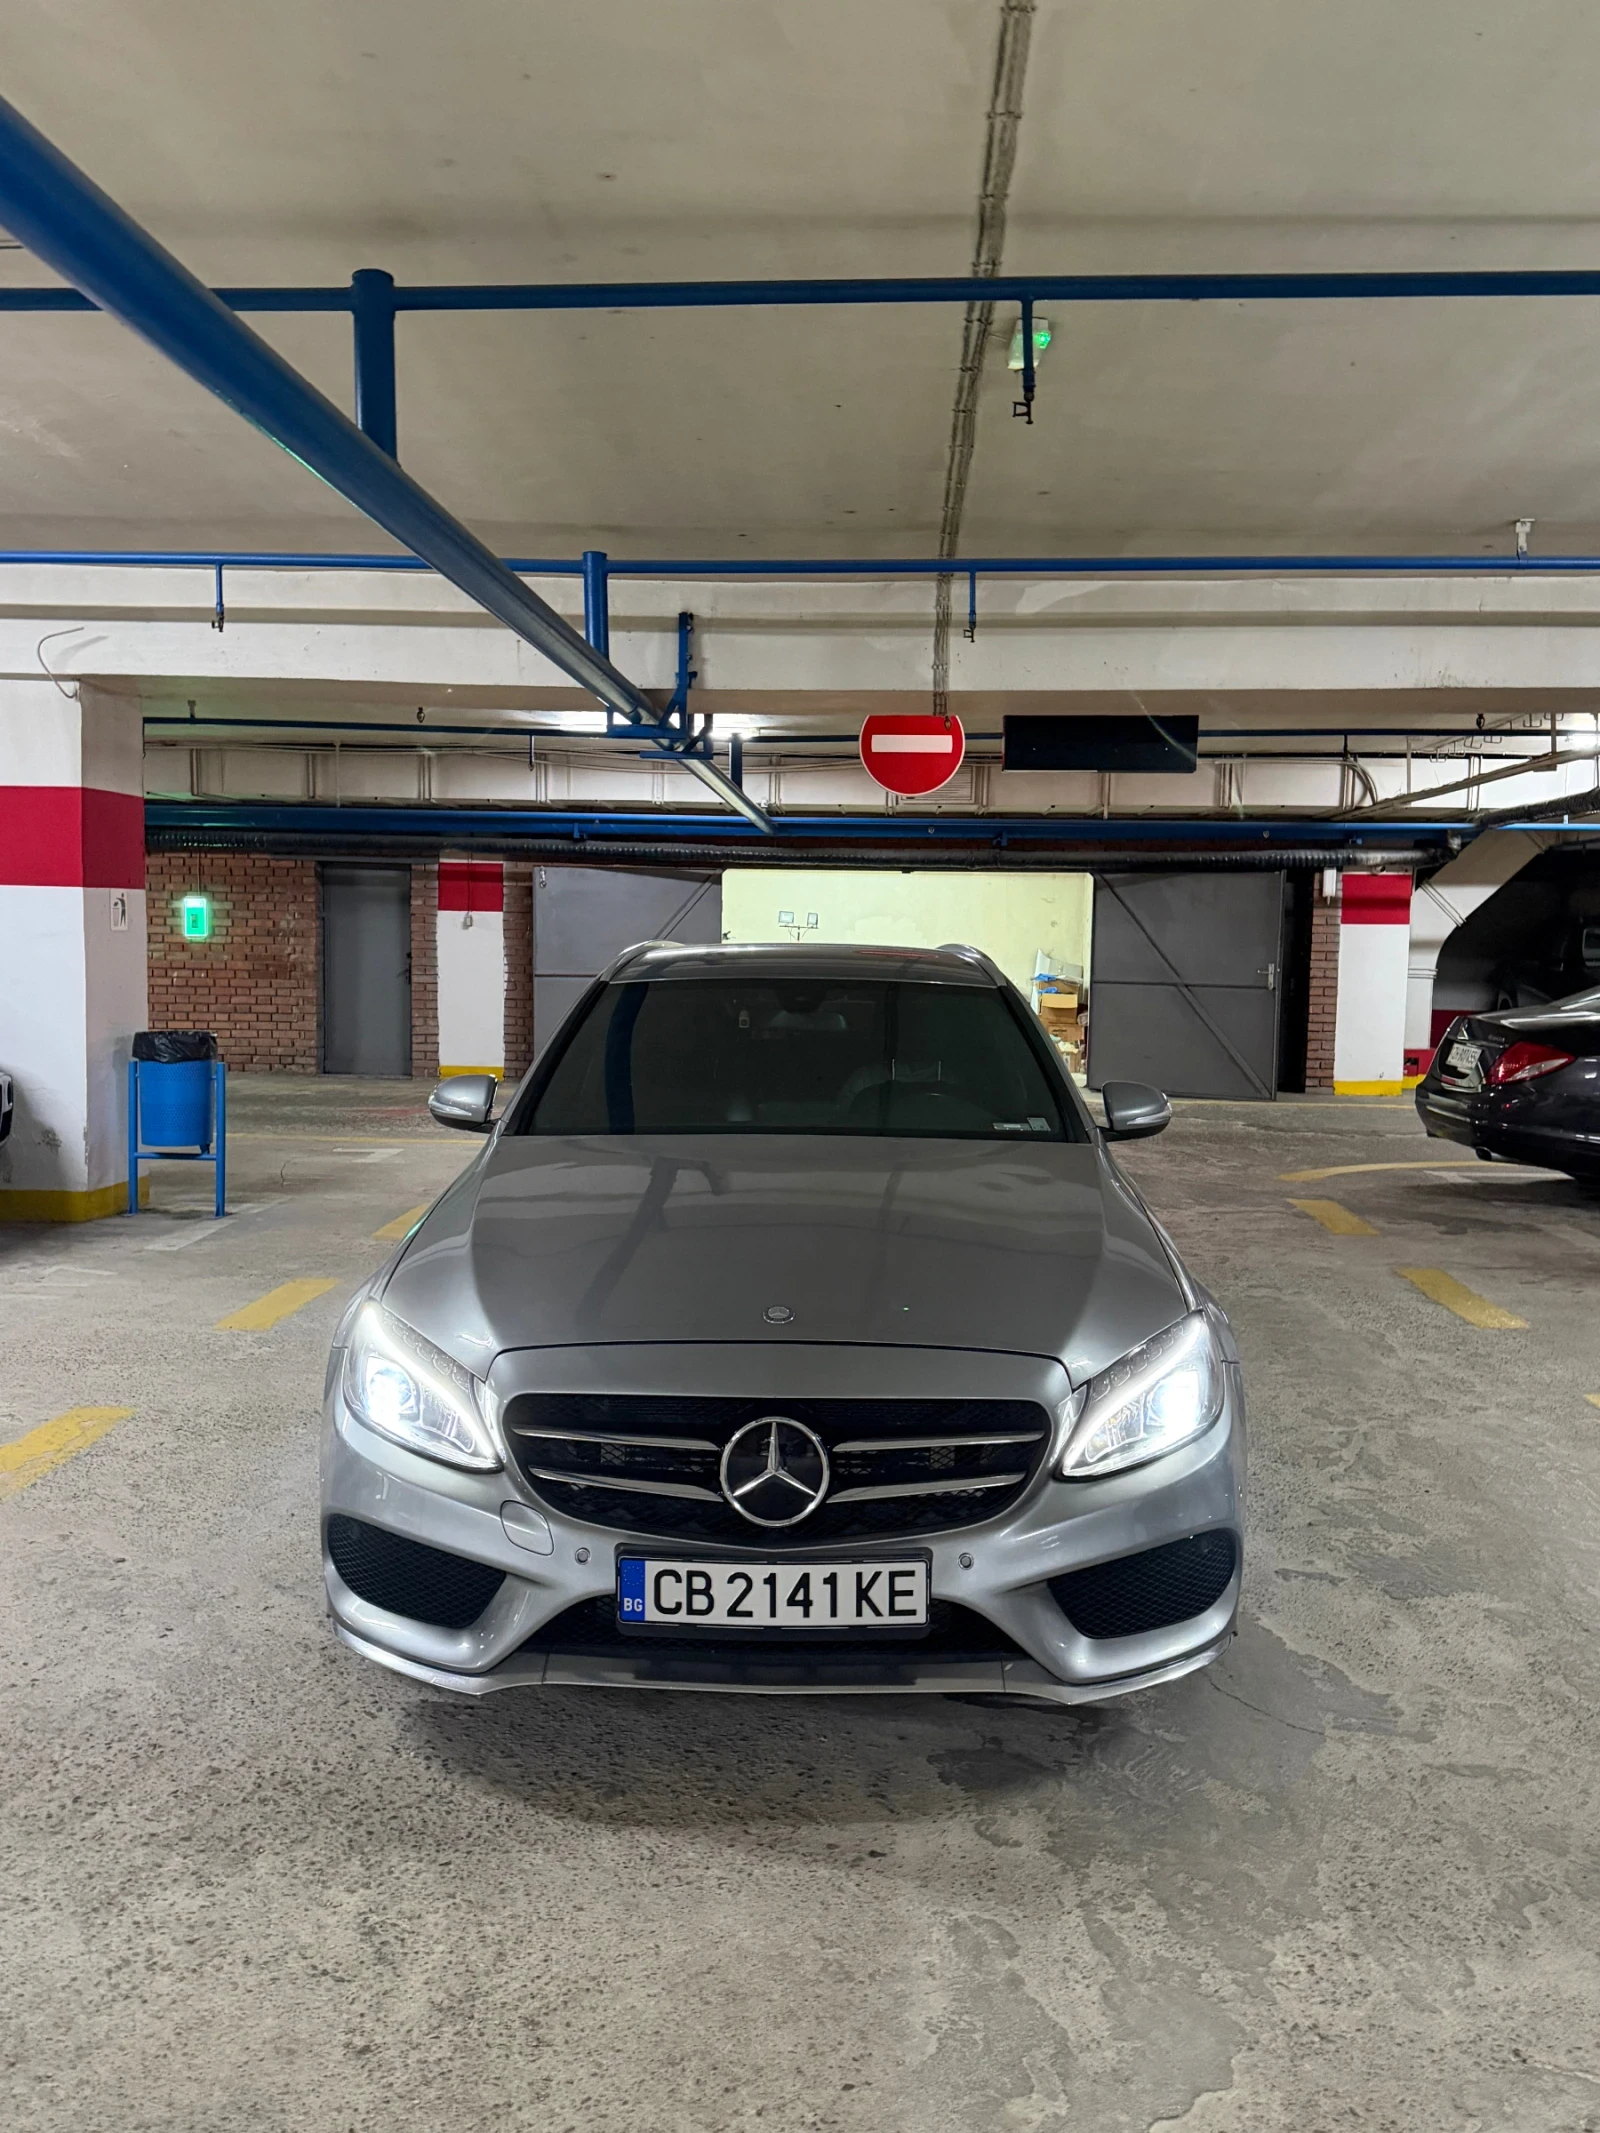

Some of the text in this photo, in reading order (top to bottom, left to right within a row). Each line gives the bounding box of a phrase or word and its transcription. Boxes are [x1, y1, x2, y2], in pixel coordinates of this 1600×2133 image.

[623, 1597, 643, 1612] BG
[726, 1571, 838, 1618] 2141
[855, 1570, 917, 1617] KE
